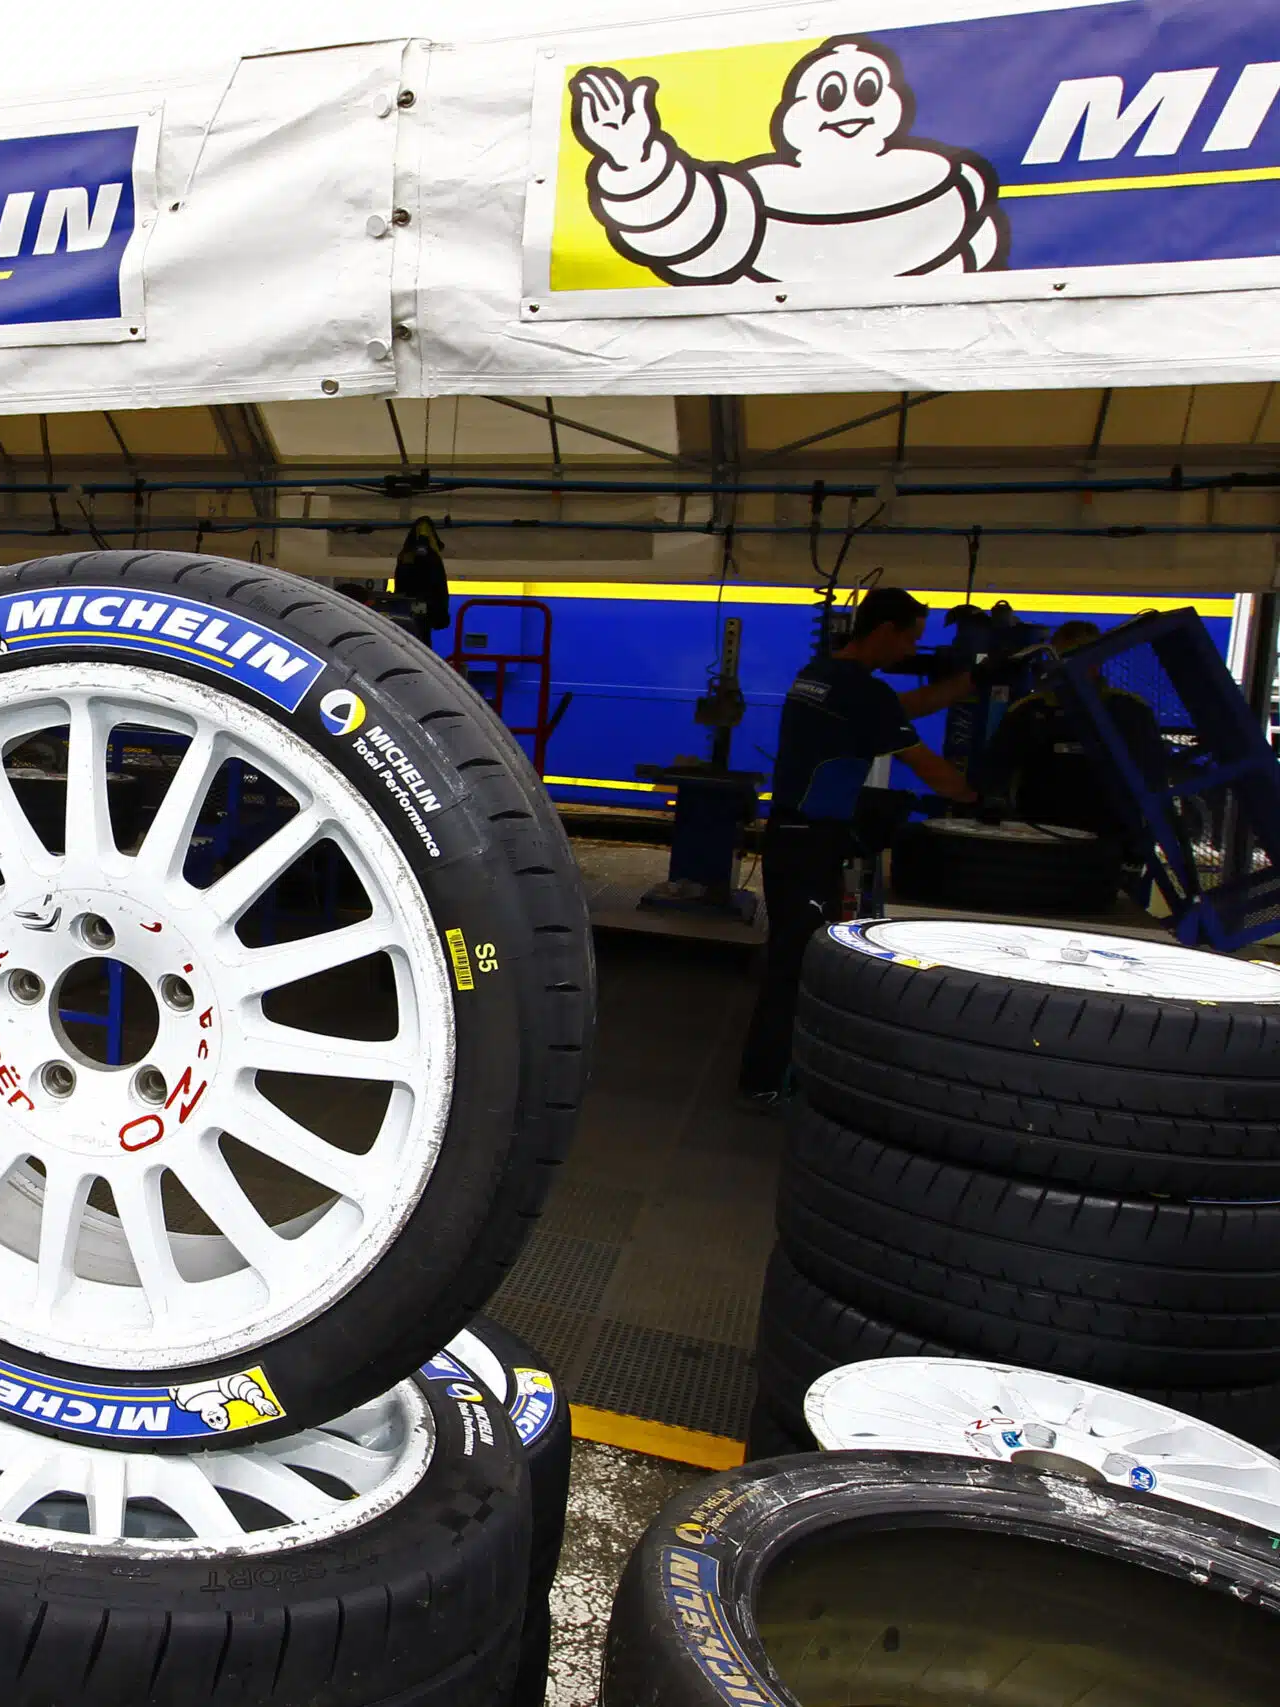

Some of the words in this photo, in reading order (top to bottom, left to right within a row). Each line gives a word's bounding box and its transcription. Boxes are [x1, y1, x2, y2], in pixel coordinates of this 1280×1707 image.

[6, 595, 309, 683] MICHELIN
[352, 736, 380, 771] Total
[379, 769, 441, 858] Performance
[365, 725, 441, 813] MICHELIN
[475, 942, 498, 973] S5
[471, 1402, 495, 1447] MICHELIN
[670, 1551, 768, 1707] ICHELIN
